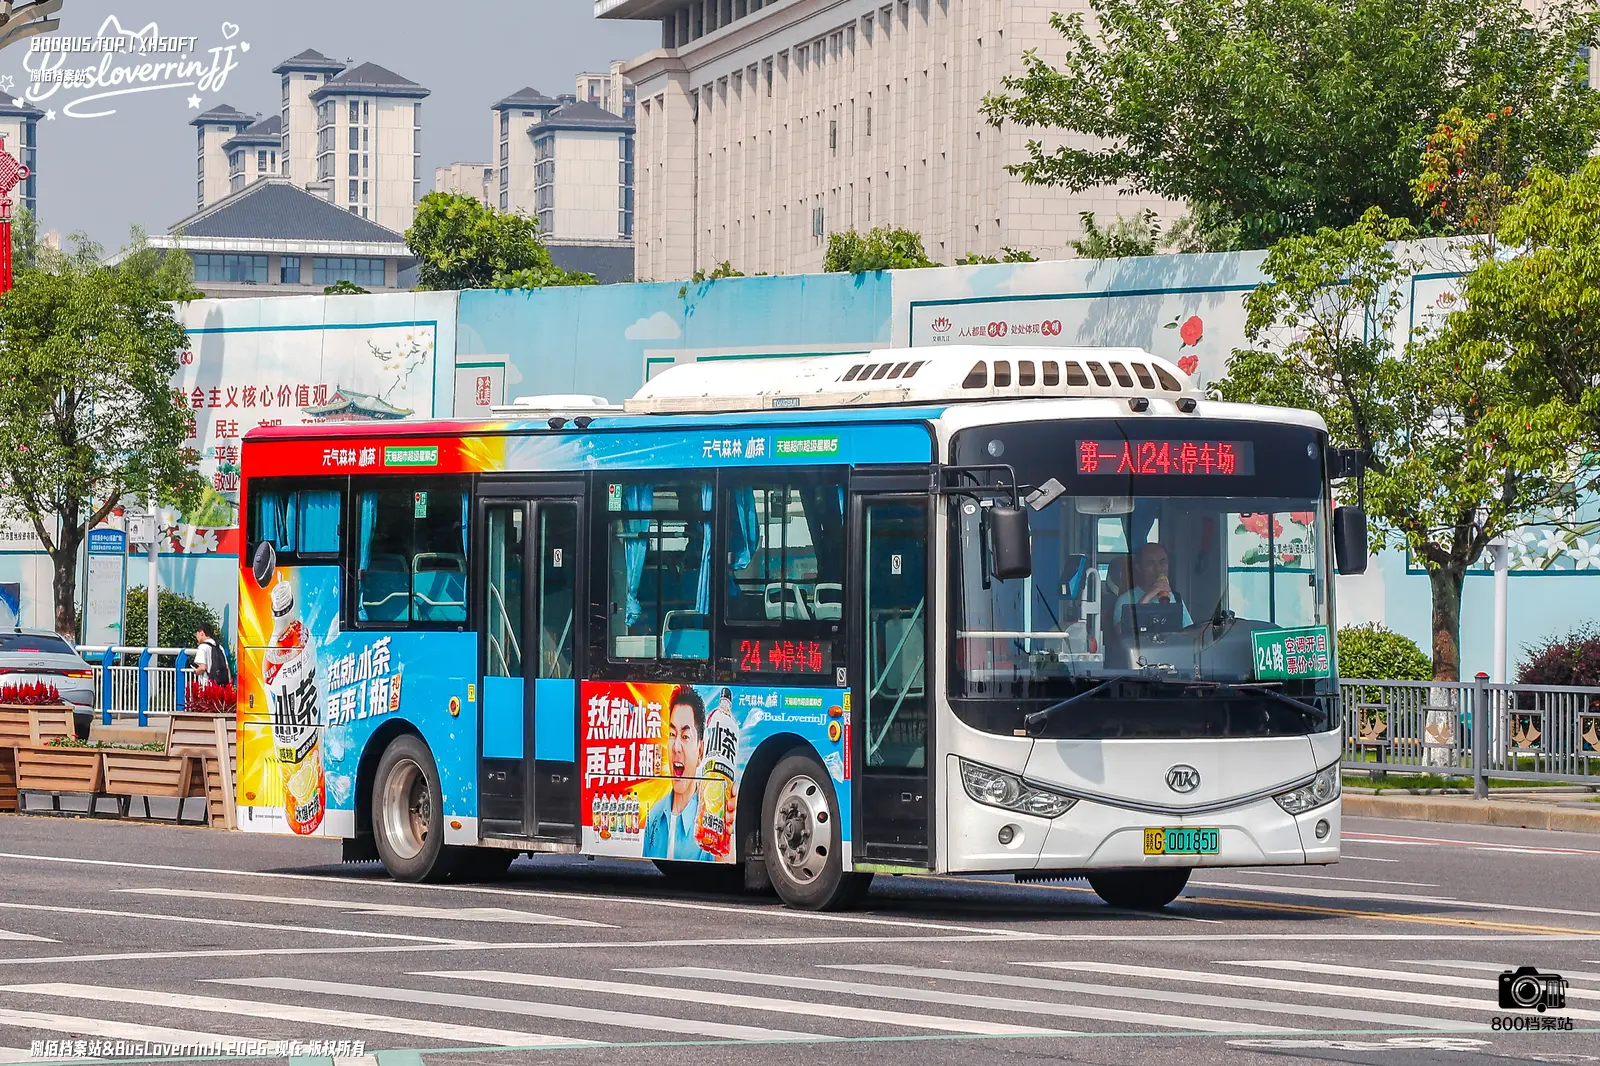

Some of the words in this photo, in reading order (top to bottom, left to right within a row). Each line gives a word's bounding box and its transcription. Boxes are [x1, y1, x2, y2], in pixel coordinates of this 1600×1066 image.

[215, 419, 239, 439] 民主
[214, 446, 239, 465] 平等
[322, 448, 357, 466] 元气森林
[702, 439, 742, 458] 元气森林
[745, 437, 765, 459] 冰茶
[213, 473, 239, 491] 敬业
[740, 640, 761, 671] 24
[1258, 641, 1284, 671] 24路
[1285, 634, 1326, 655] 空调开启
[328, 635, 391, 693] 热就冰茶
[274, 666, 318, 735] 冰茶
[327, 678, 390, 728] 再来1瓶
[586, 692, 662, 740] 热就冰茶
[705, 721, 737, 765] 冰茶
[585, 741, 654, 789] 再来1瓶
